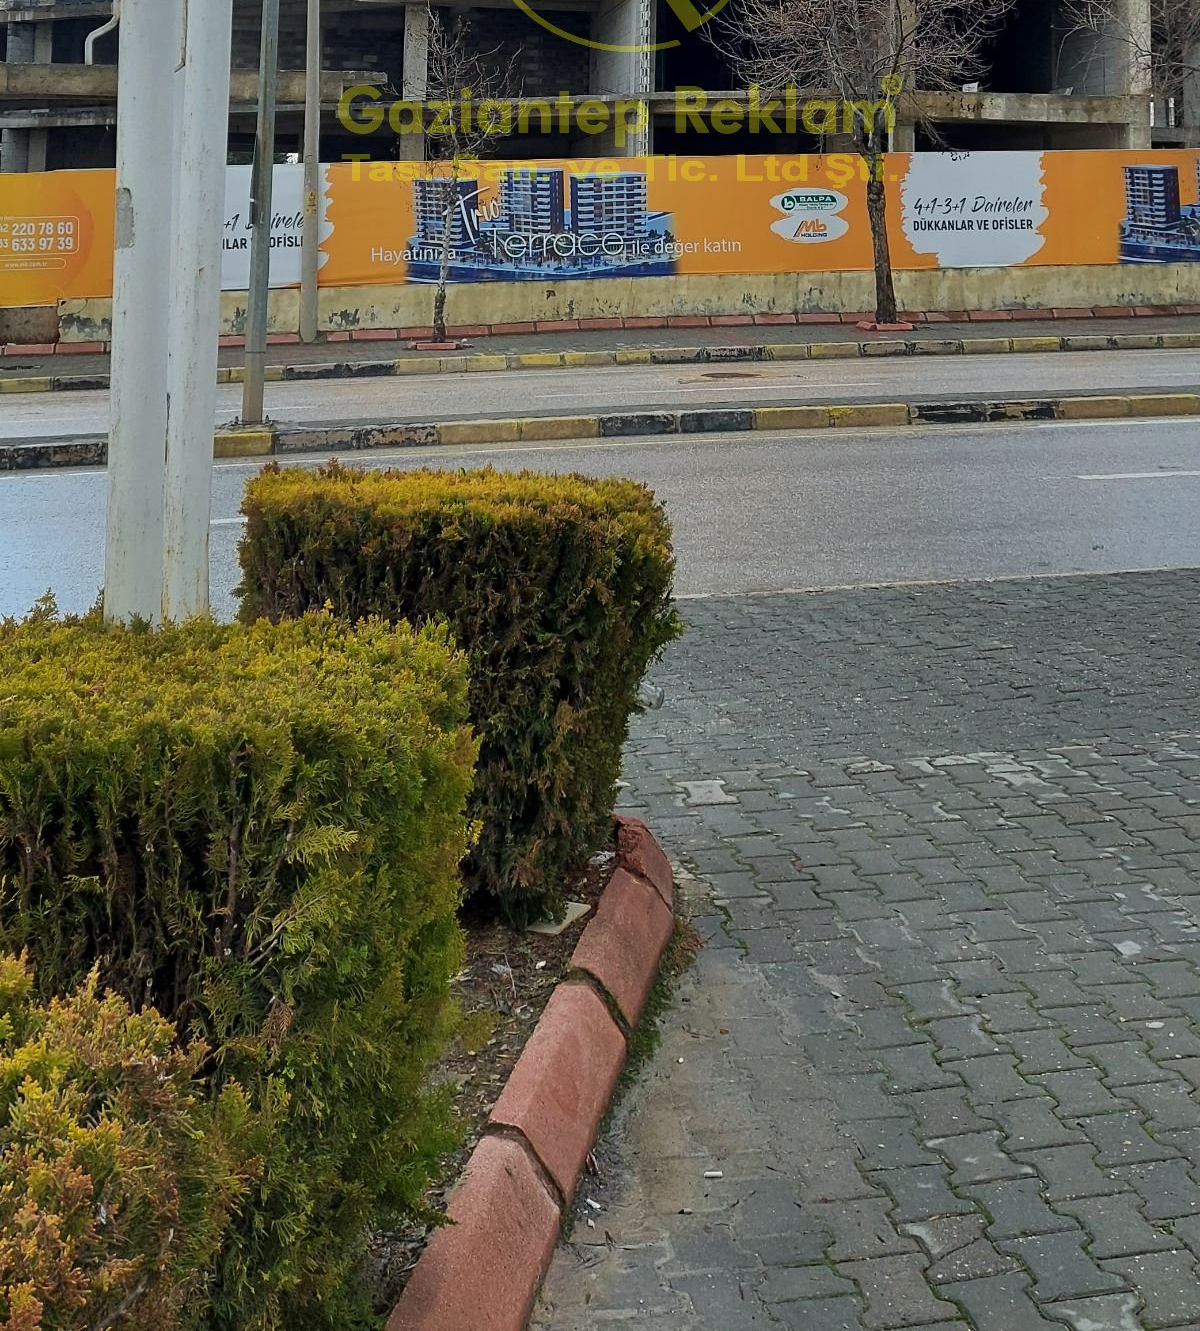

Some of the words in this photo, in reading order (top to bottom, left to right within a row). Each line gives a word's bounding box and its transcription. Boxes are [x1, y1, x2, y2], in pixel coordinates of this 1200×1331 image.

[913, 197, 967, 215] 4+1-3+1
[971, 195, 1033, 213] Daireler
[442, 186, 501, 245] Trio
[913, 218, 974, 231] DÜKKANLAR
[976, 220, 989, 229] VE
[992, 217, 1033, 230] OFİSLER
[11, 223, 35, 236] 220
[38, 222, 54, 235] 78
[57, 221, 73, 235] 60
[11, 238, 35, 252] 633
[39, 237, 54, 250] 97
[57, 236, 73, 250] 39
[480, 227, 625, 259] Terrace
[631, 238, 648, 255] ile
[653, 238, 698, 258] değer
[703, 237, 742, 253] katın
